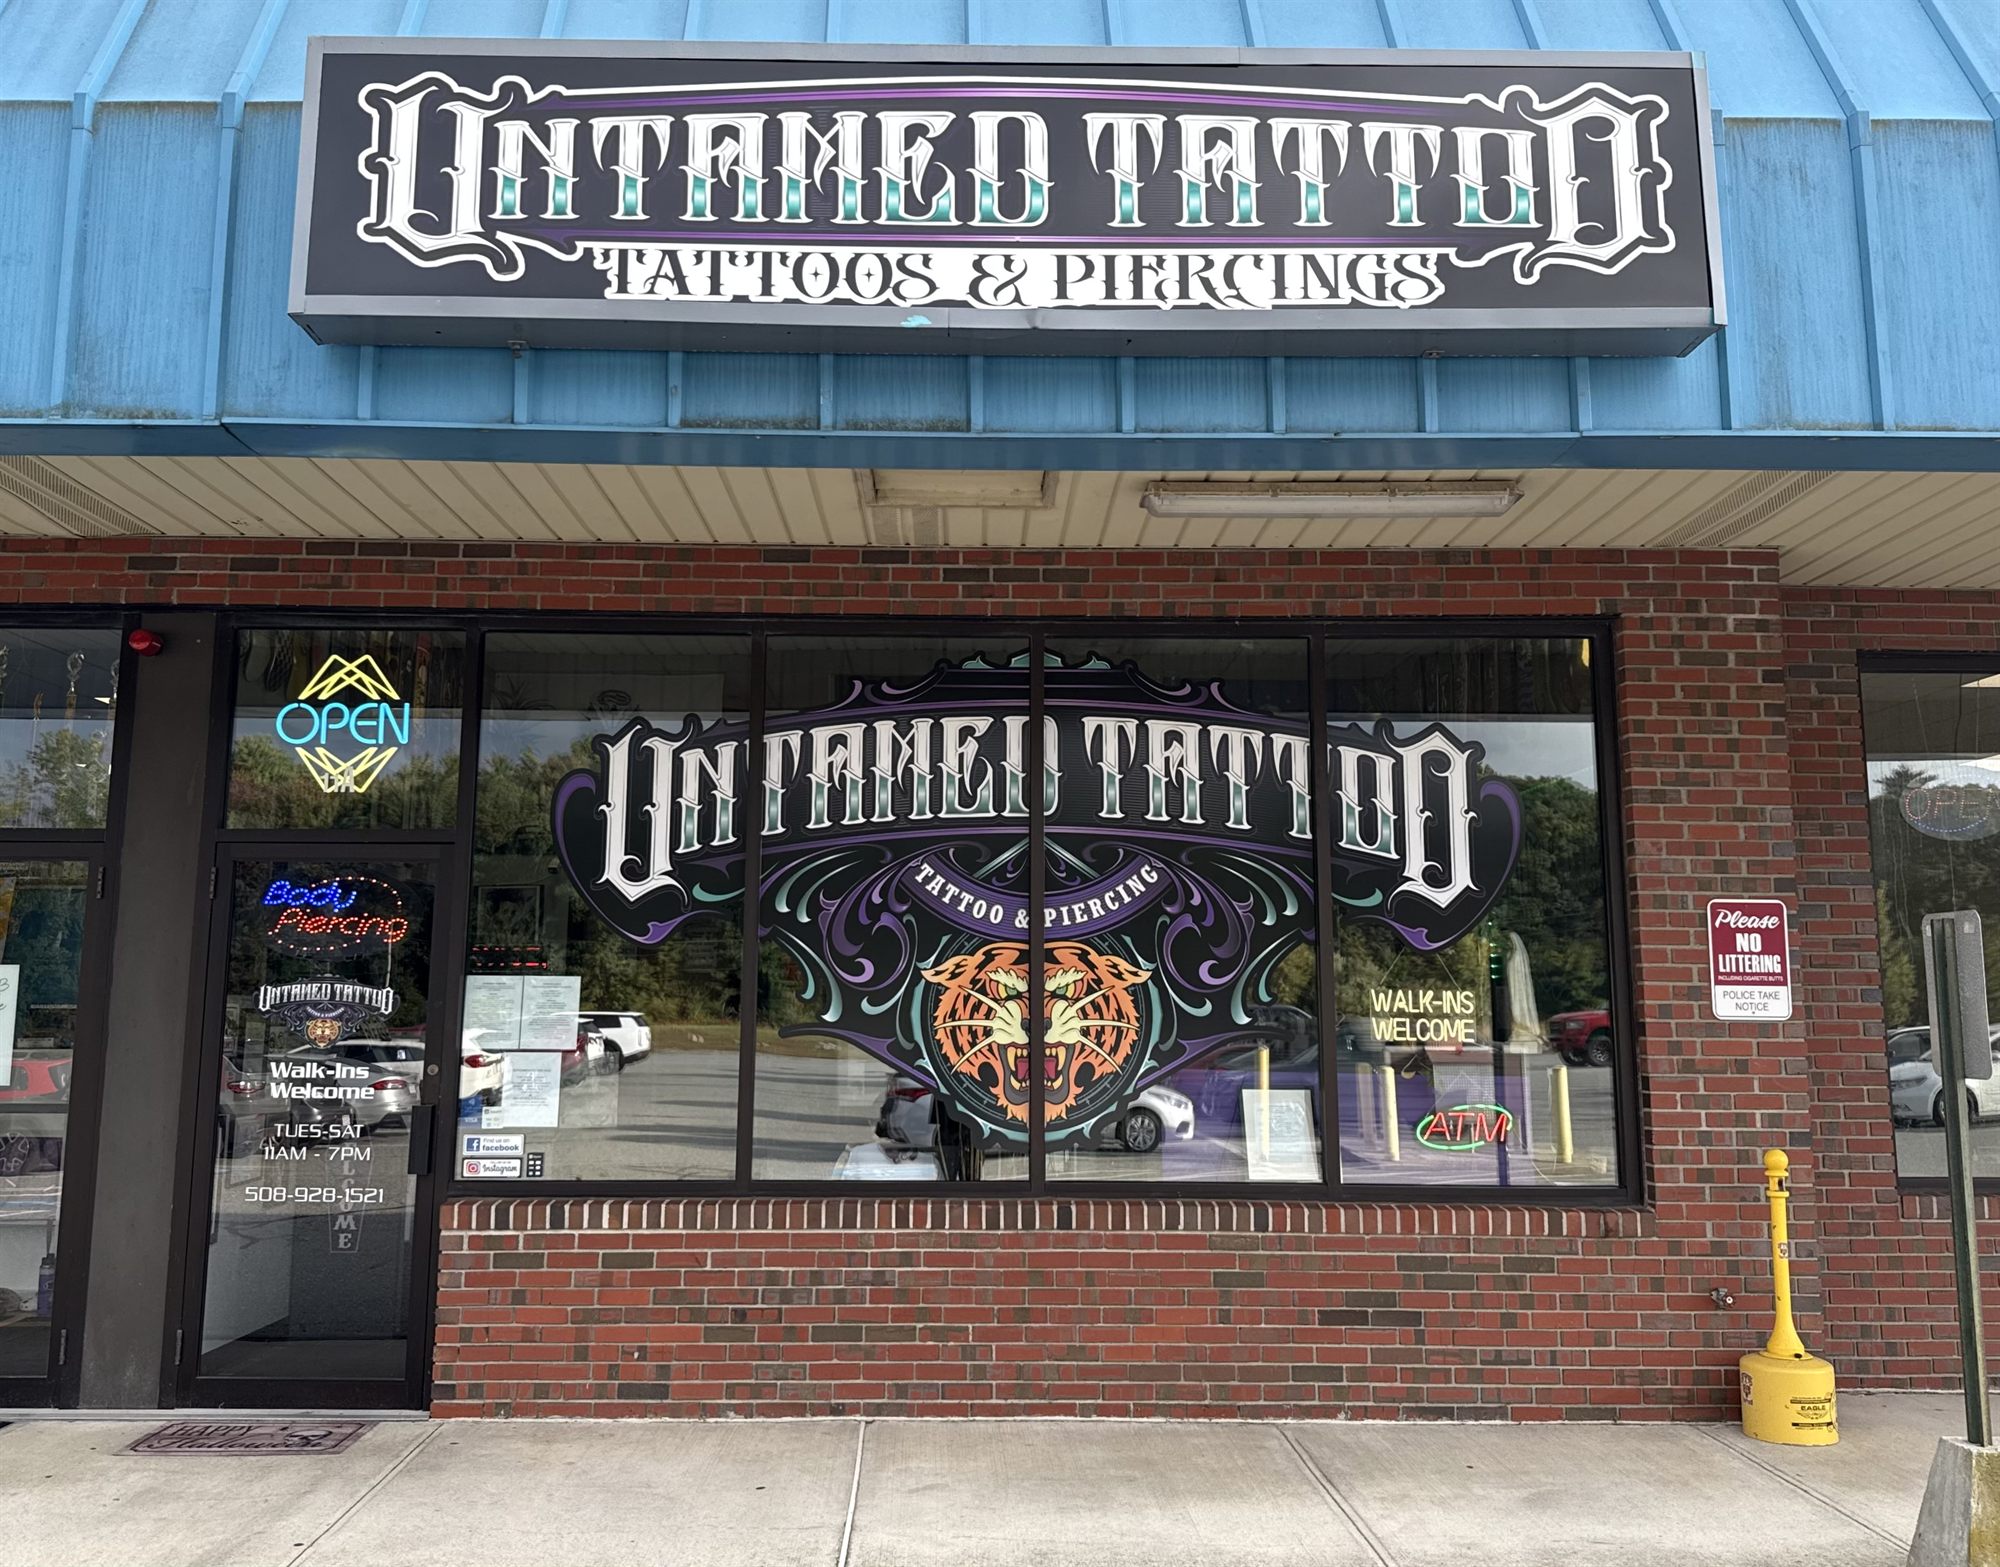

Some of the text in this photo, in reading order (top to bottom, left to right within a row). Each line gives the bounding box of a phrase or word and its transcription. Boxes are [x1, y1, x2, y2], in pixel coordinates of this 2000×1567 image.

[374, 86, 1657, 272] UNTAMED TATTOO
[598, 248, 1440, 309] TATTOOS & PIERCINGS
[275, 702, 411, 745] OPEN
[597, 715, 1479, 916] UNTAMED TATTOO
[263, 880, 358, 913] Body
[914, 862, 1160, 929] TATTOO & PIERCING
[1714, 908, 1780, 929] Please
[1735, 932, 1762, 953] NO
[1718, 953, 1782, 973] LITTERING
[259, 983, 394, 1015] UNTAMED TATTOO
[1370, 988, 1475, 1014] WALK-INS
[1722, 990, 1780, 1000] POLICE TAKE
[1735, 1002, 1769, 1012] NOTICE
[1371, 1018, 1475, 1043] WELCOME
[269, 1061, 370, 1079] Walk-Ins
[270, 1082, 375, 1100] Welcome
[274, 1123, 365, 1139] TUES-SAT
[1423, 1112, 1508, 1142] ATM
[263, 1146, 307, 1161] 11AM
[328, 1146, 371, 1161] 7PM
[482, 1144, 520, 1152] facebook
[482, 1164, 518, 1175] Instagram
[244, 1186, 384, 1203] 508-928-1521
[171, 1425, 258, 1436] HAPPY
